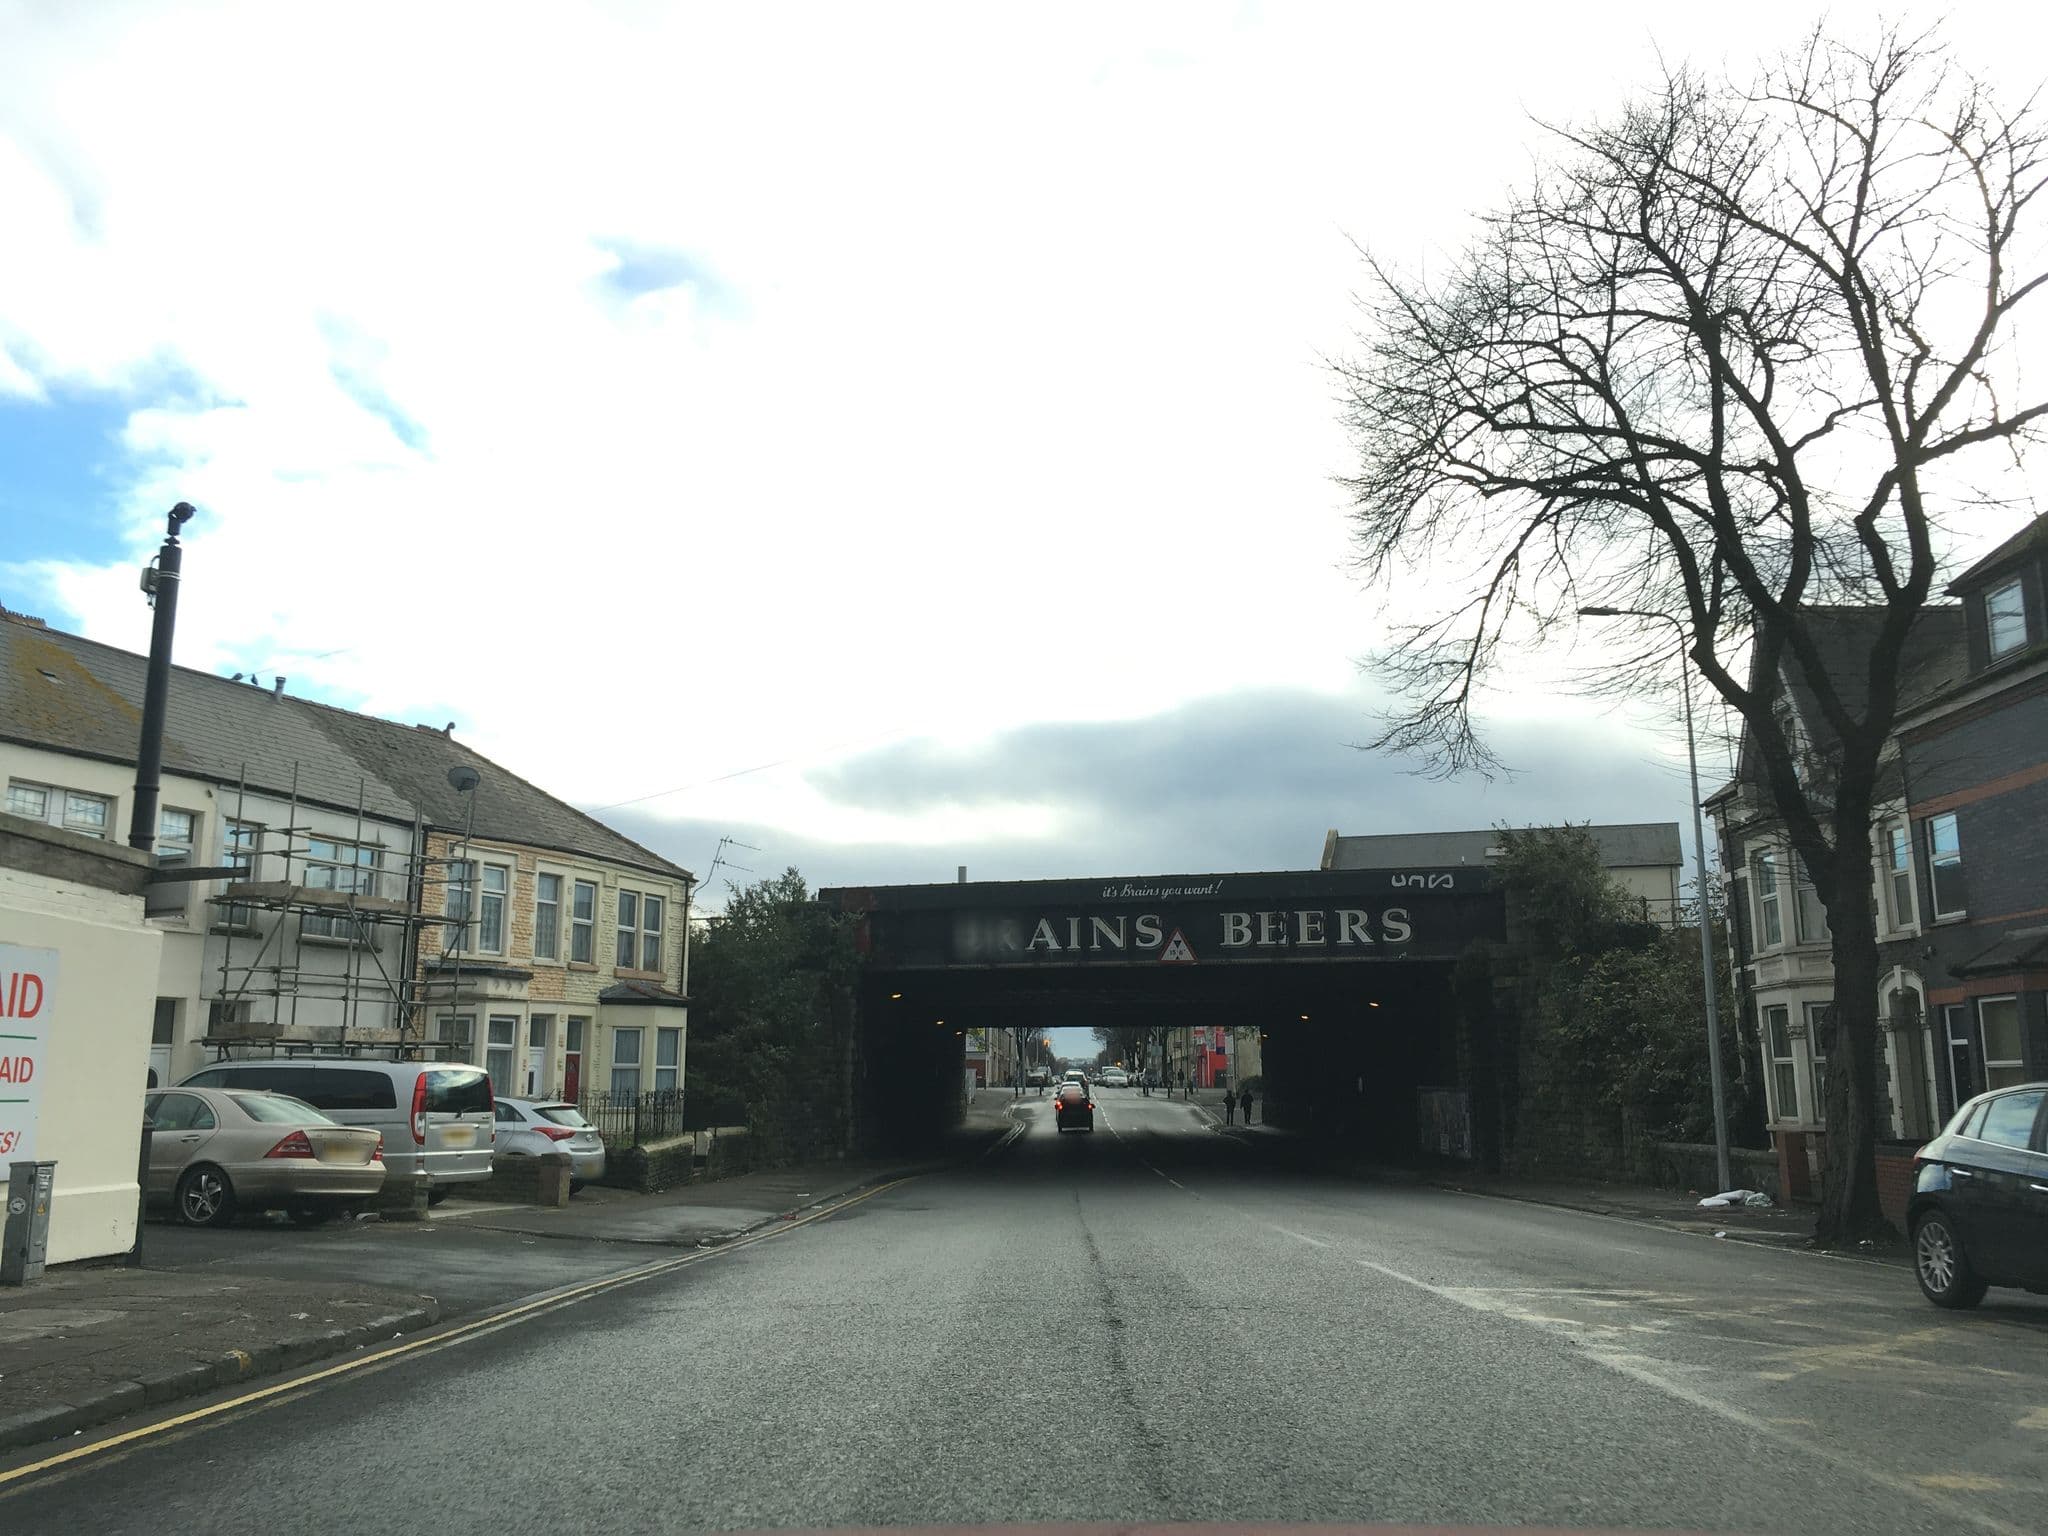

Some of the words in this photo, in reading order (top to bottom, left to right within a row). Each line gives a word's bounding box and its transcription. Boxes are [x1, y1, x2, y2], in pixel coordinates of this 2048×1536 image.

[1119, 883, 1160, 897] Brains
[1161, 887, 1182, 900] you
[1183, 879, 1223, 895] want!
[953, 914, 1164, 951] AINS
[1219, 908, 1413, 947] BEERS
[0, 1131, 21, 1154] S!
